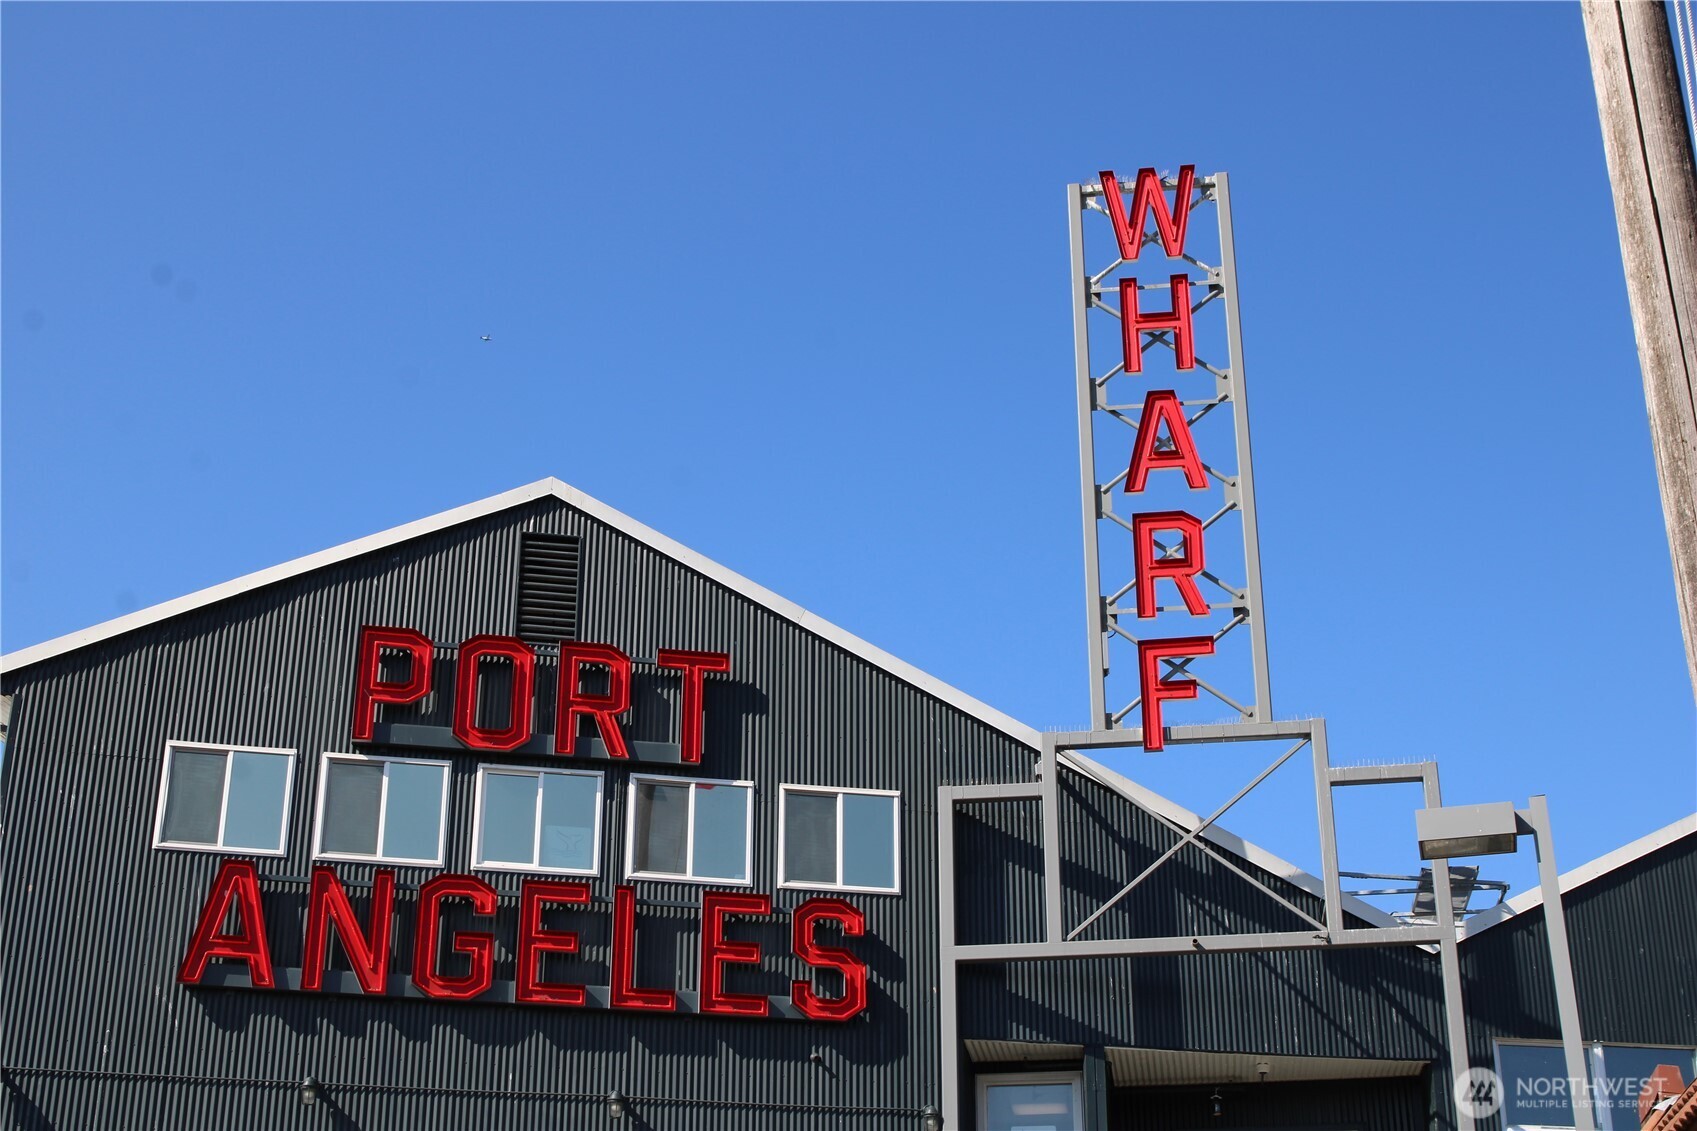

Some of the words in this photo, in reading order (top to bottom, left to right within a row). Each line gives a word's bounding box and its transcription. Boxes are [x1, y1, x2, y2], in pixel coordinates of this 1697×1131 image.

[1099, 164, 1214, 751] WHARF
[353, 625, 729, 764] PORT
[178, 860, 868, 1020] ANGELES
